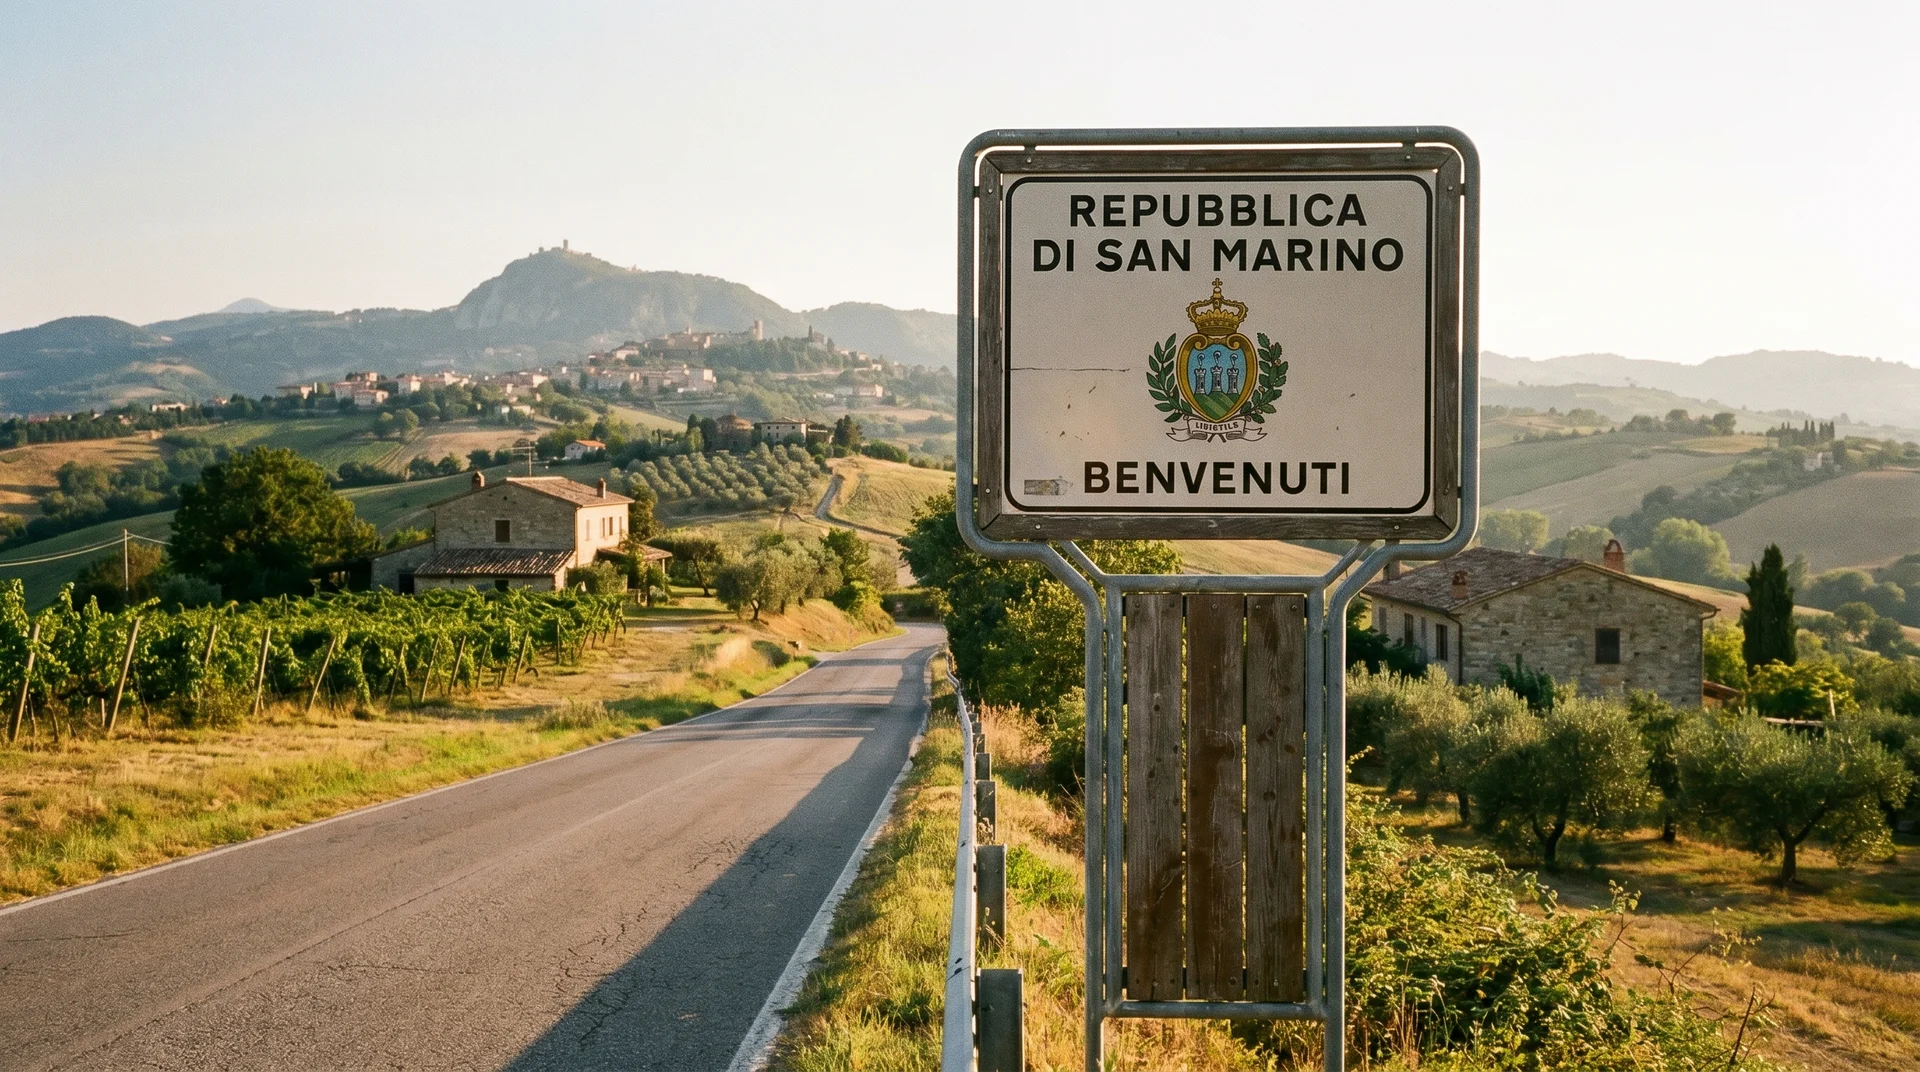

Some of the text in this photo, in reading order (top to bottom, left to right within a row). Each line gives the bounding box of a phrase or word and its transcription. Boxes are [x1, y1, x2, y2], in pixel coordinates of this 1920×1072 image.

[1070, 193, 1367, 228] REPUBBLICA
[1033, 237, 1404, 273] DI SAN MARINO
[1084, 461, 1350, 495] BENVENUTI
